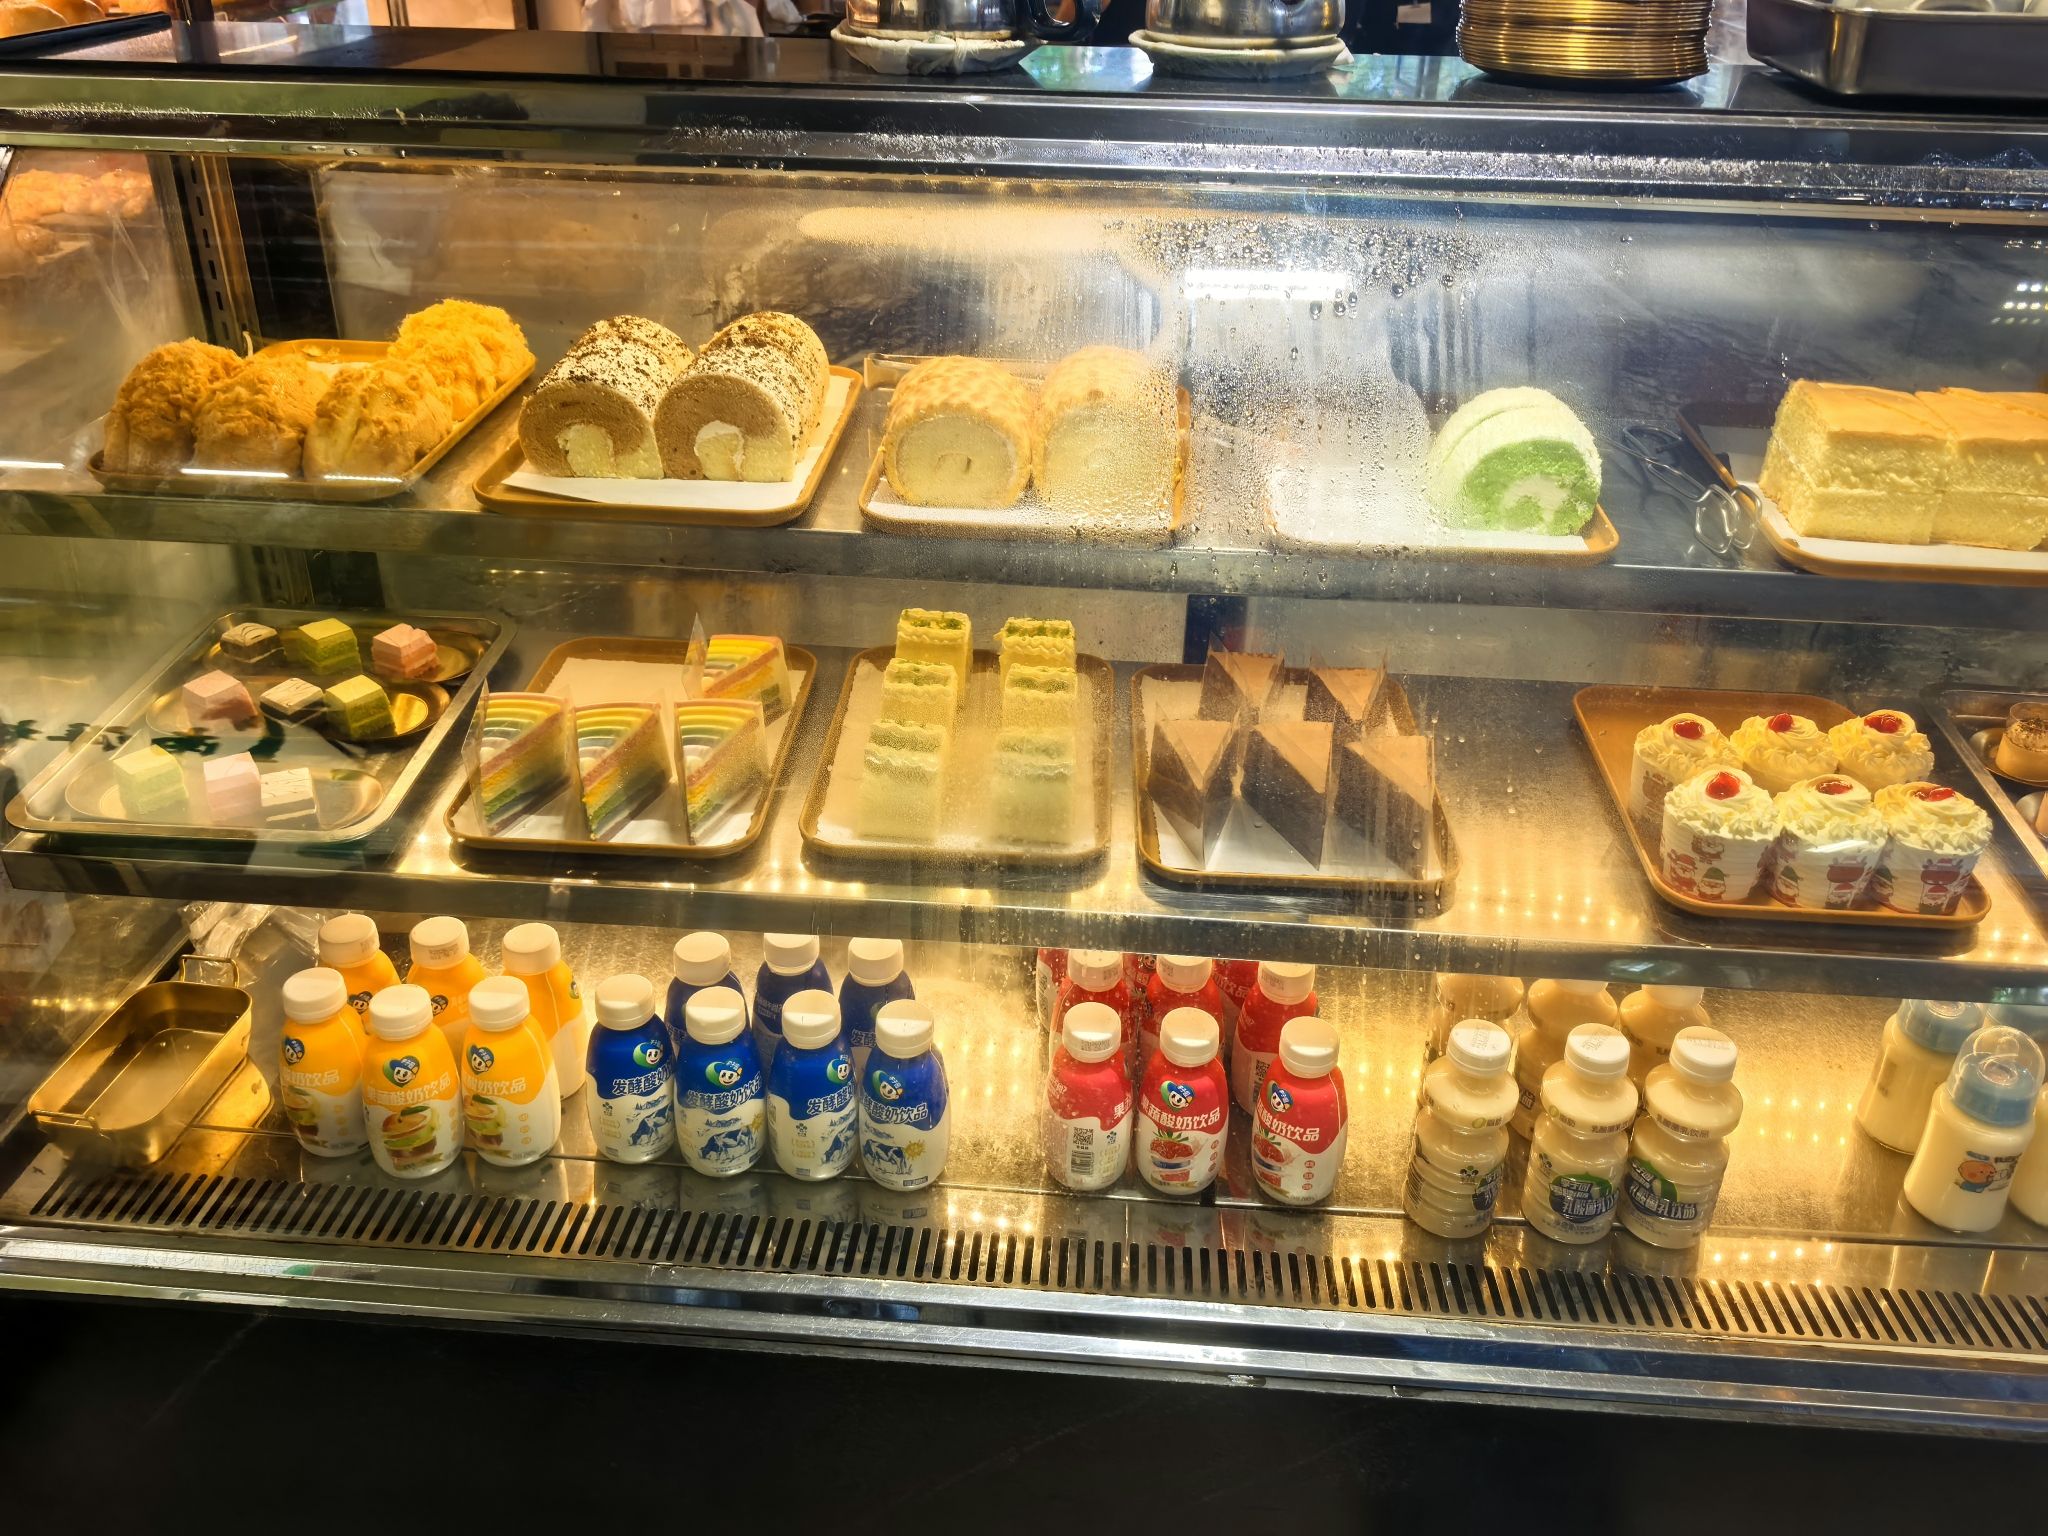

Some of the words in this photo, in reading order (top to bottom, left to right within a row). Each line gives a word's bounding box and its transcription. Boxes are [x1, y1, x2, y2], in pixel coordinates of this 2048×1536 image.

[686, 1070, 763, 1111] 发酵酸奶饮品
[1141, 1092, 1221, 1131] 果蔬酸奶饮品
